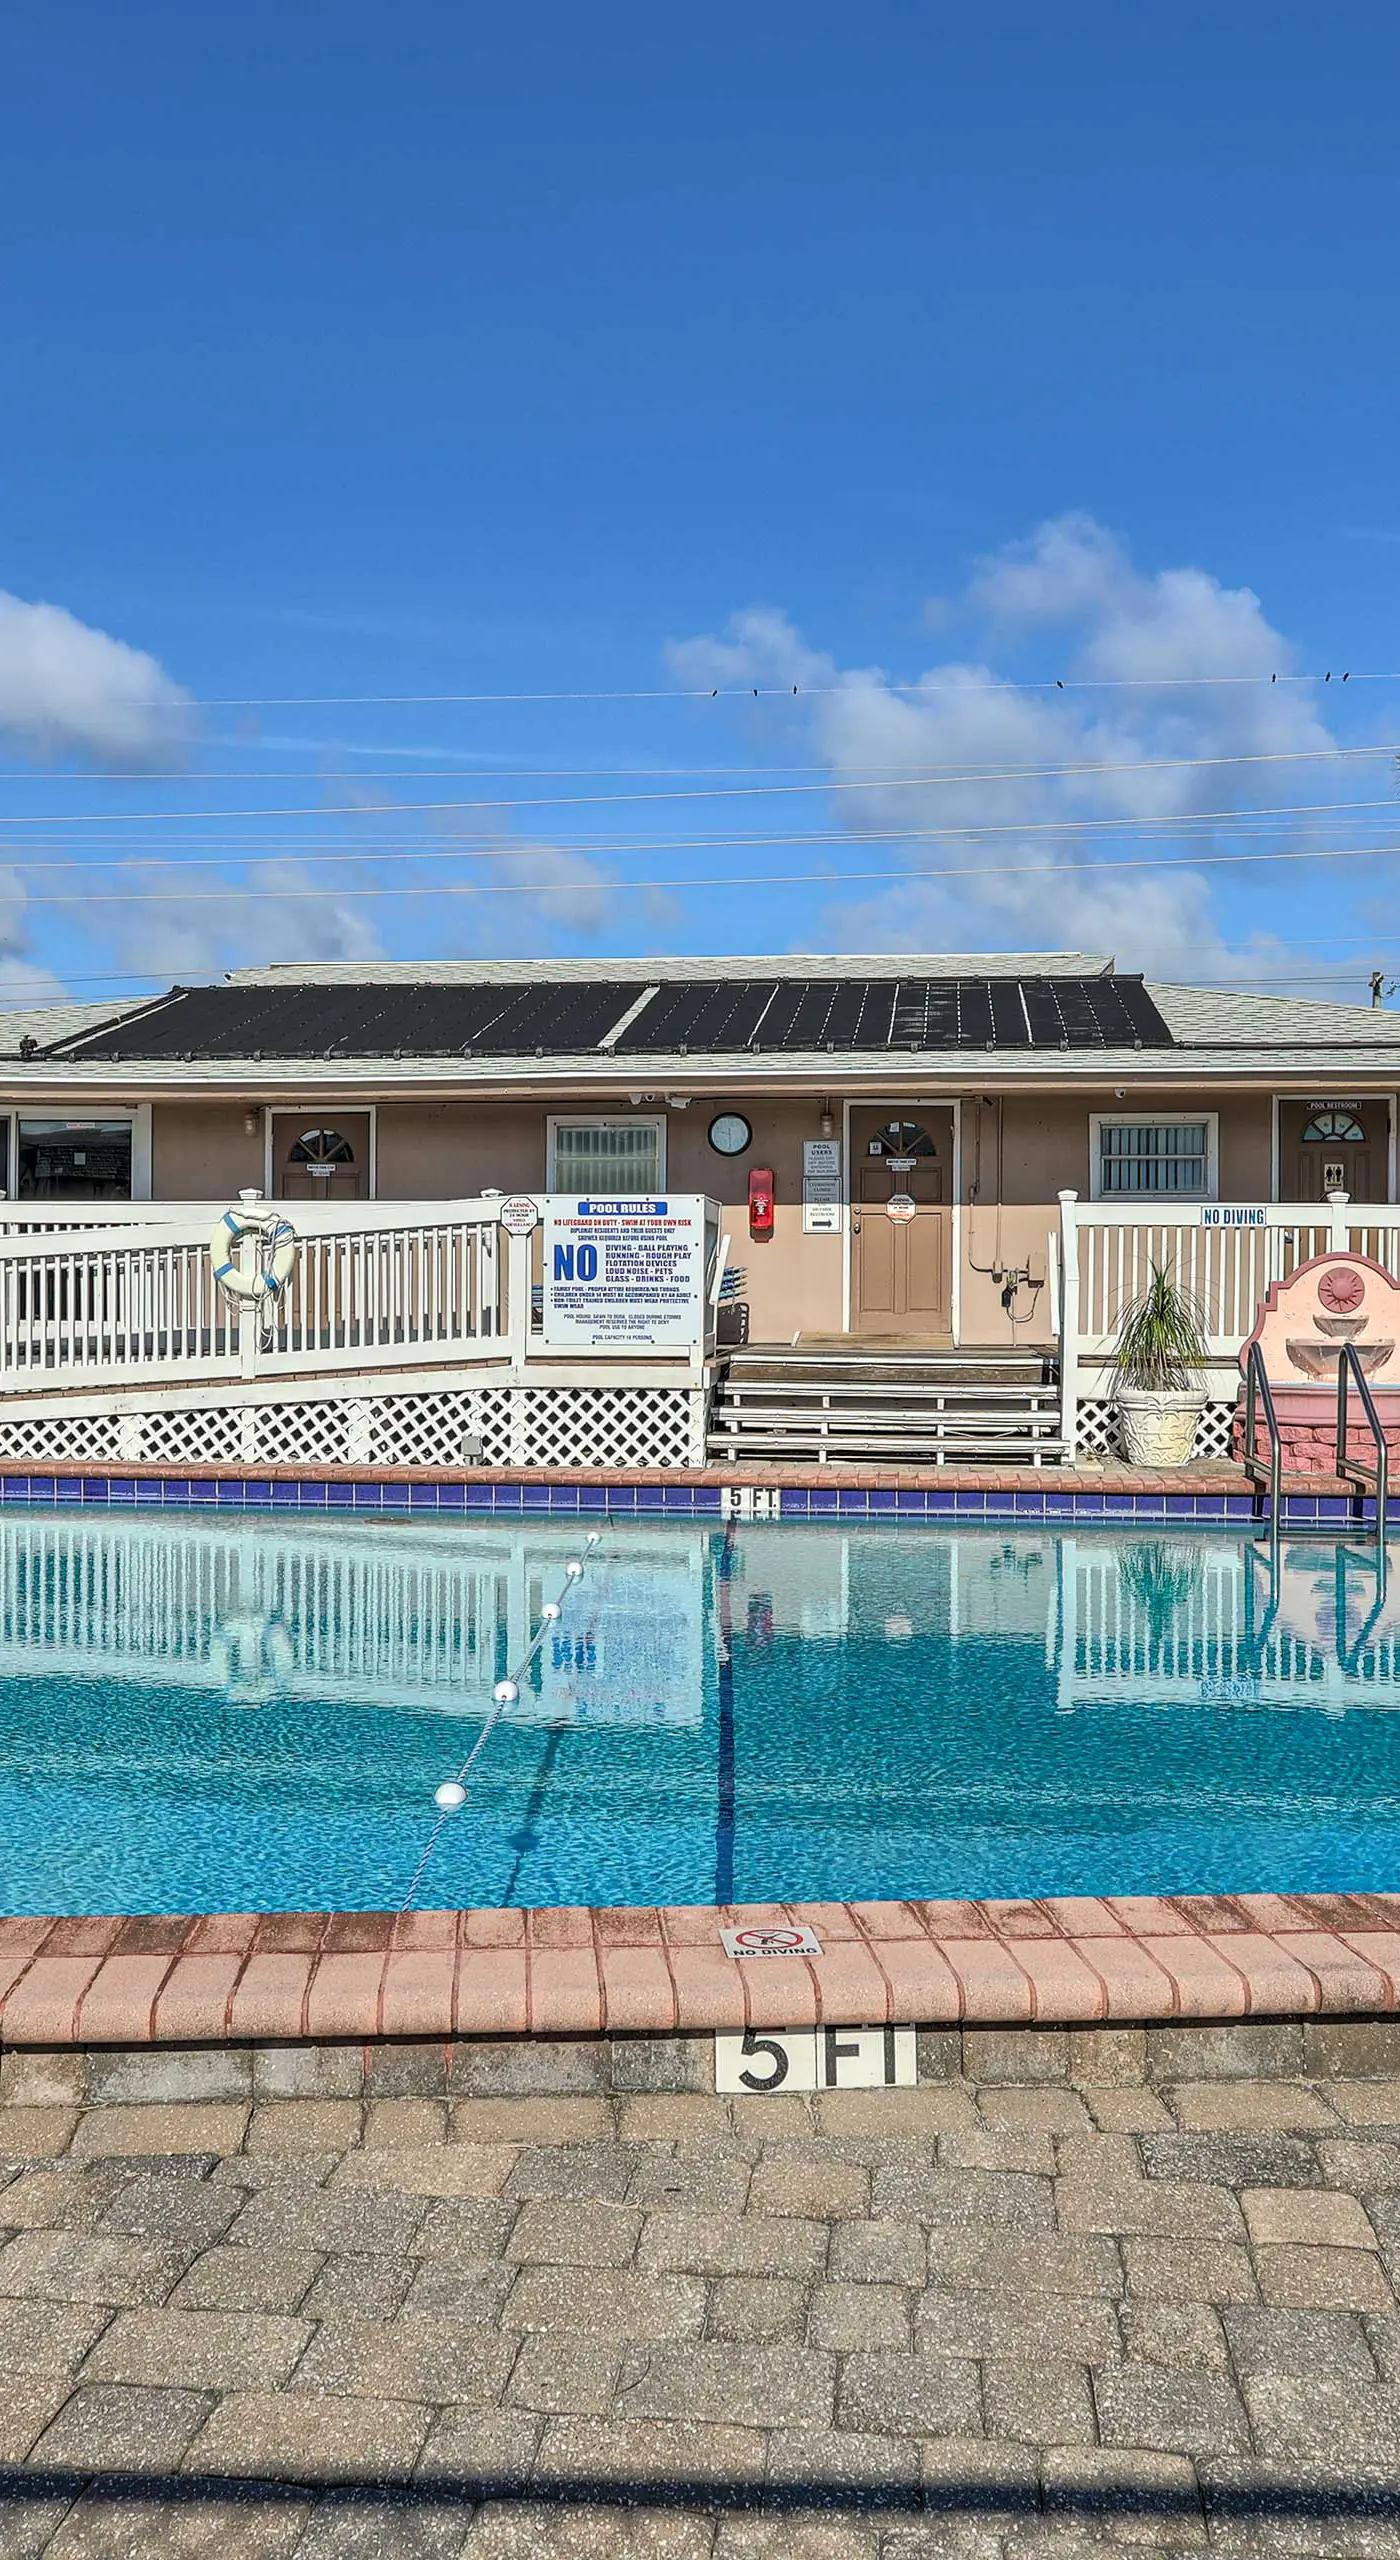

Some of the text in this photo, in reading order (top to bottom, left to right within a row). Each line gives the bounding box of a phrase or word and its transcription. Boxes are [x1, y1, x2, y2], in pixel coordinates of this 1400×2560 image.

[589, 1203, 656, 1214] POOL RULES
[1204, 1208, 1264, 1224] NO DIVING
[554, 1244, 597, 1281] NO
[731, 1487, 776, 1507] 5 FT.
[762, 1947, 817, 1955] DIVING
[738, 2023, 910, 2091] 5 FT
